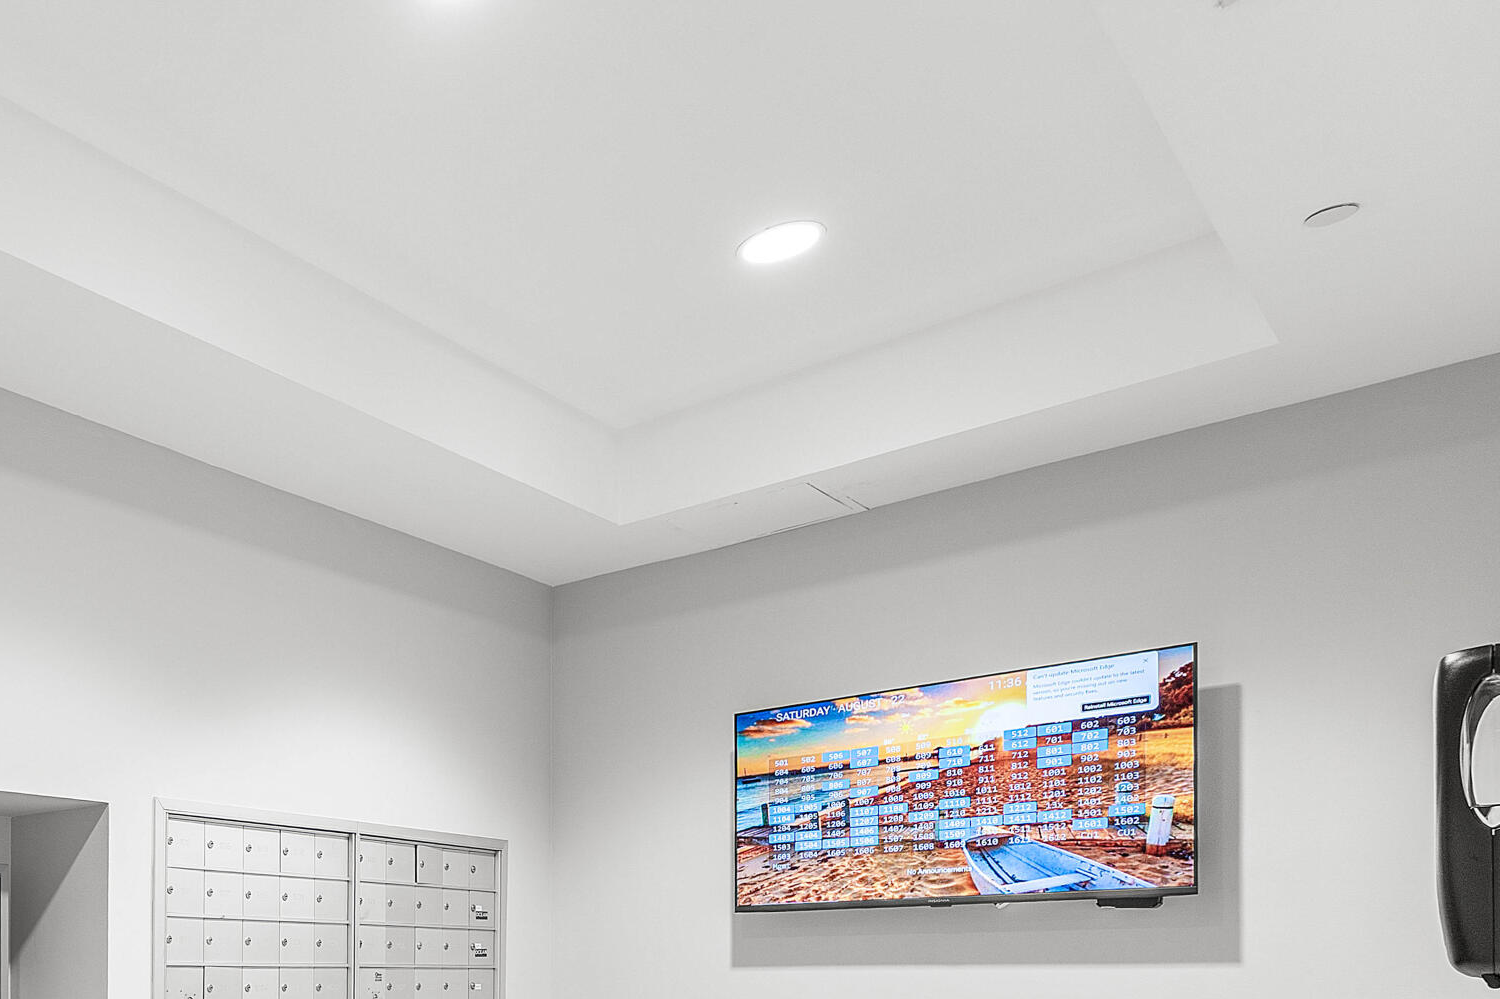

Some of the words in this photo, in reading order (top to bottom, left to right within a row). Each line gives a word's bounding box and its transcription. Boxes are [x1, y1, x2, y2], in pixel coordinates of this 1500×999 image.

[990, 678, 1022, 690] 11:36
[776, 706, 830, 722] SATURDAY
[838, 698, 882, 713] AUGUST
[891, 695, 905, 704] 22
[1107, 699, 1132, 707] Microsoft
[1133, 697, 1148, 705] Edge
[1012, 730, 1028, 738] 512
[1046, 725, 1063, 734] 601
[1081, 720, 1099, 729] 602
[1117, 716, 1136, 724] 603
[1012, 740, 1028, 748] 612
[1046, 736, 1063, 744] 701
[1081, 731, 1099, 740] 702
[1117, 727, 1136, 736] 703
[1012, 751, 1028, 759] 712
[1046, 747, 1063, 755] 801
[1081, 742, 1099, 751] 802
[1117, 738, 1136, 747] 803
[1012, 761, 1028, 769] 812
[1046, 758, 1063, 766] 901
[1081, 753, 1099, 762] 902
[1117, 750, 1136, 758] 903
[1012, 772, 1028, 780] 912
[1043, 768, 1066, 777] 1001
[1078, 764, 1102, 773] 1002
[1114, 760, 1139, 770] 1003
[913, 792, 934, 800] 1009
[944, 789, 966, 797] 1010
[976, 786, 998, 794] 1011
[1009, 782, 1031, 791] 1012
[1043, 779, 1066, 788] 1101
[1078, 775, 1102, 784] 1102
[1114, 772, 1139, 781] 1103
[944, 799, 966, 808] 1110
[1009, 793, 1031, 801] 1112
[1043, 790, 1066, 799] 1201
[1078, 786, 1102, 795] 1202
[1114, 783, 1139, 792] 1203
[913, 813, 934, 821] 1209
[944, 810, 966, 818] 1210
[1009, 804, 1031, 812] 1212
[1078, 797, 1102, 806] 1401
[944, 820, 966, 828] 1409
[976, 817, 998, 825] 1410
[1009, 814, 1031, 823] 1411
[1043, 812, 1066, 820] 1412
[1114, 806, 1139, 814] 1502
[944, 830, 966, 839] 1509
[1078, 819, 1102, 828] 1601
[1114, 817, 1139, 826] 1602
[913, 843, 934, 851] 1608
[944, 841, 966, 849] 1609
[976, 838, 998, 846] 1610
[1009, 835, 1031, 844] 1611
